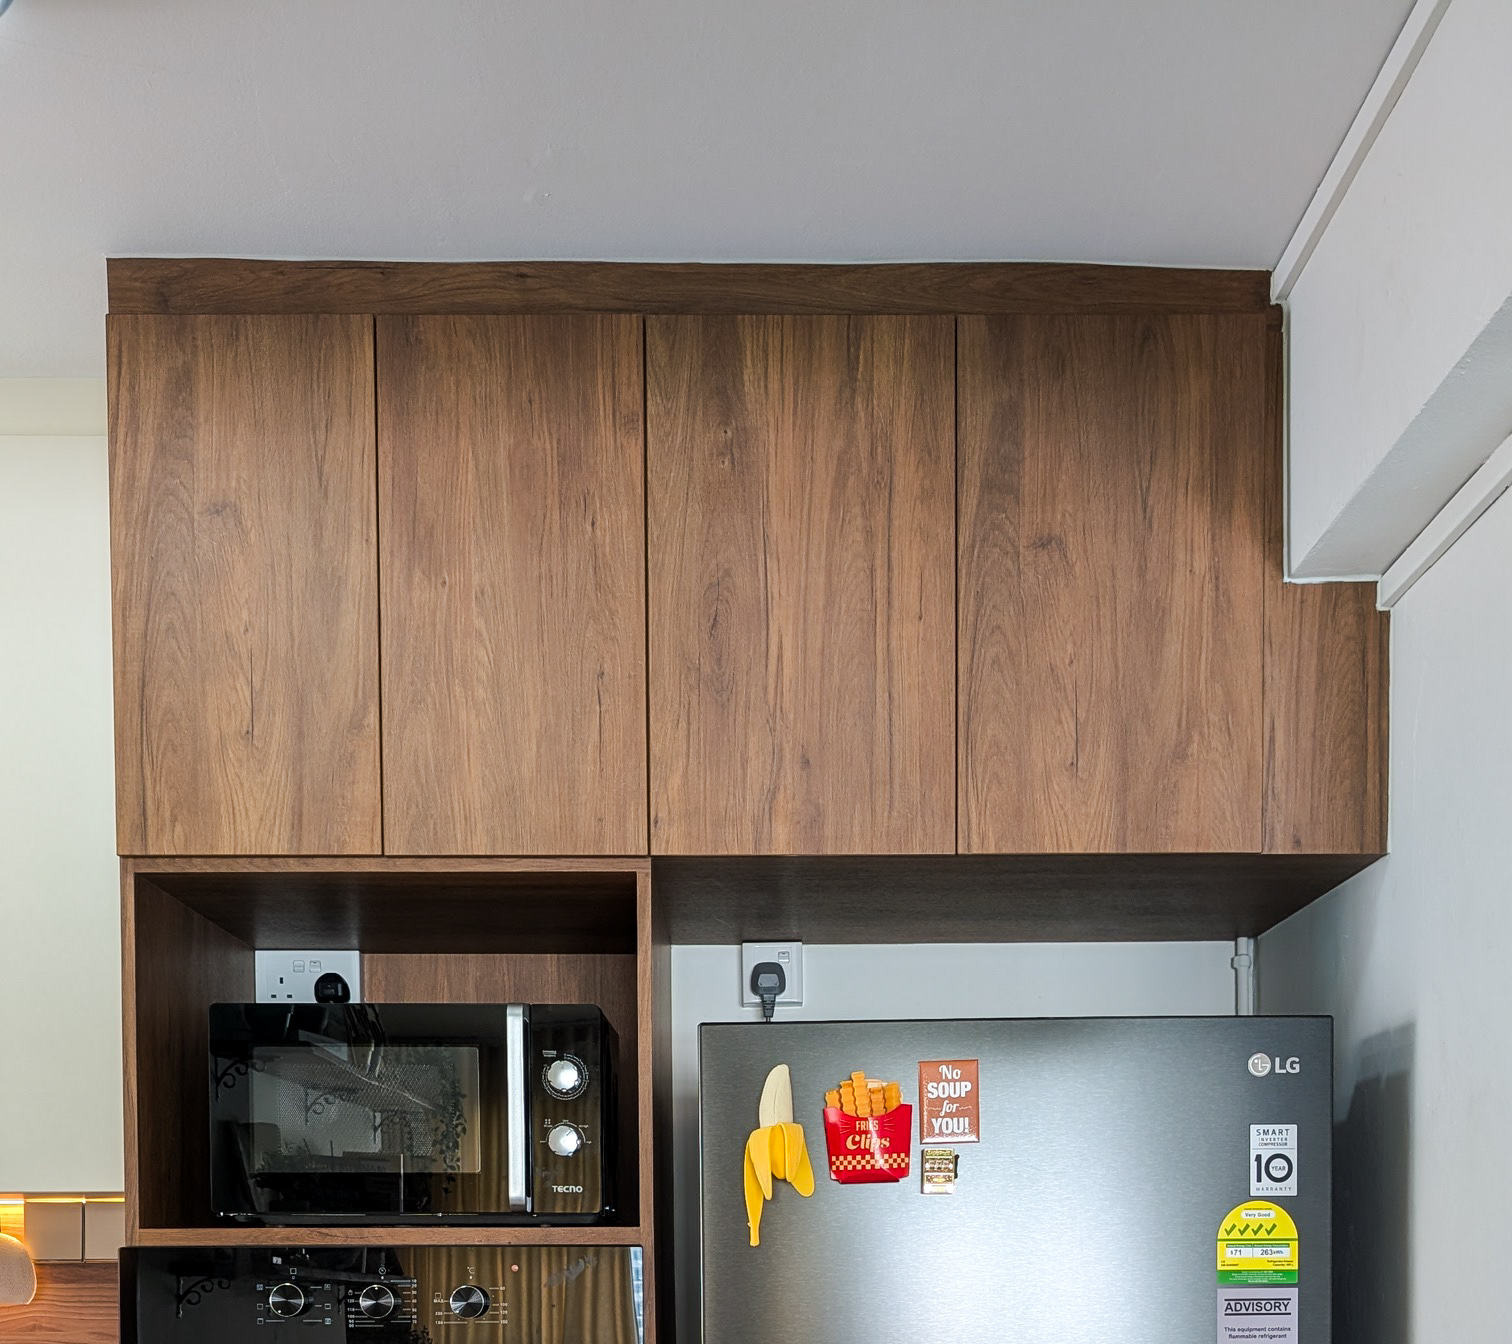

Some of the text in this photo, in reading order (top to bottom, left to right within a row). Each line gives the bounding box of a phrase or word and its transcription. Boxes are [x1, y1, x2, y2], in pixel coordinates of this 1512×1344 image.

[939, 1065, 961, 1080] No
[1275, 1057, 1300, 1073] LG
[927, 1081, 972, 1098] SOUP
[940, 1100, 959, 1116] for
[931, 1117, 969, 1134] YOU!
[846, 1134, 890, 1152] Clips
[1254, 1153, 1293, 1183] 10
[552, 1185, 583, 1193] TECNO
[1224, 1301, 1290, 1312] ADVISORY
